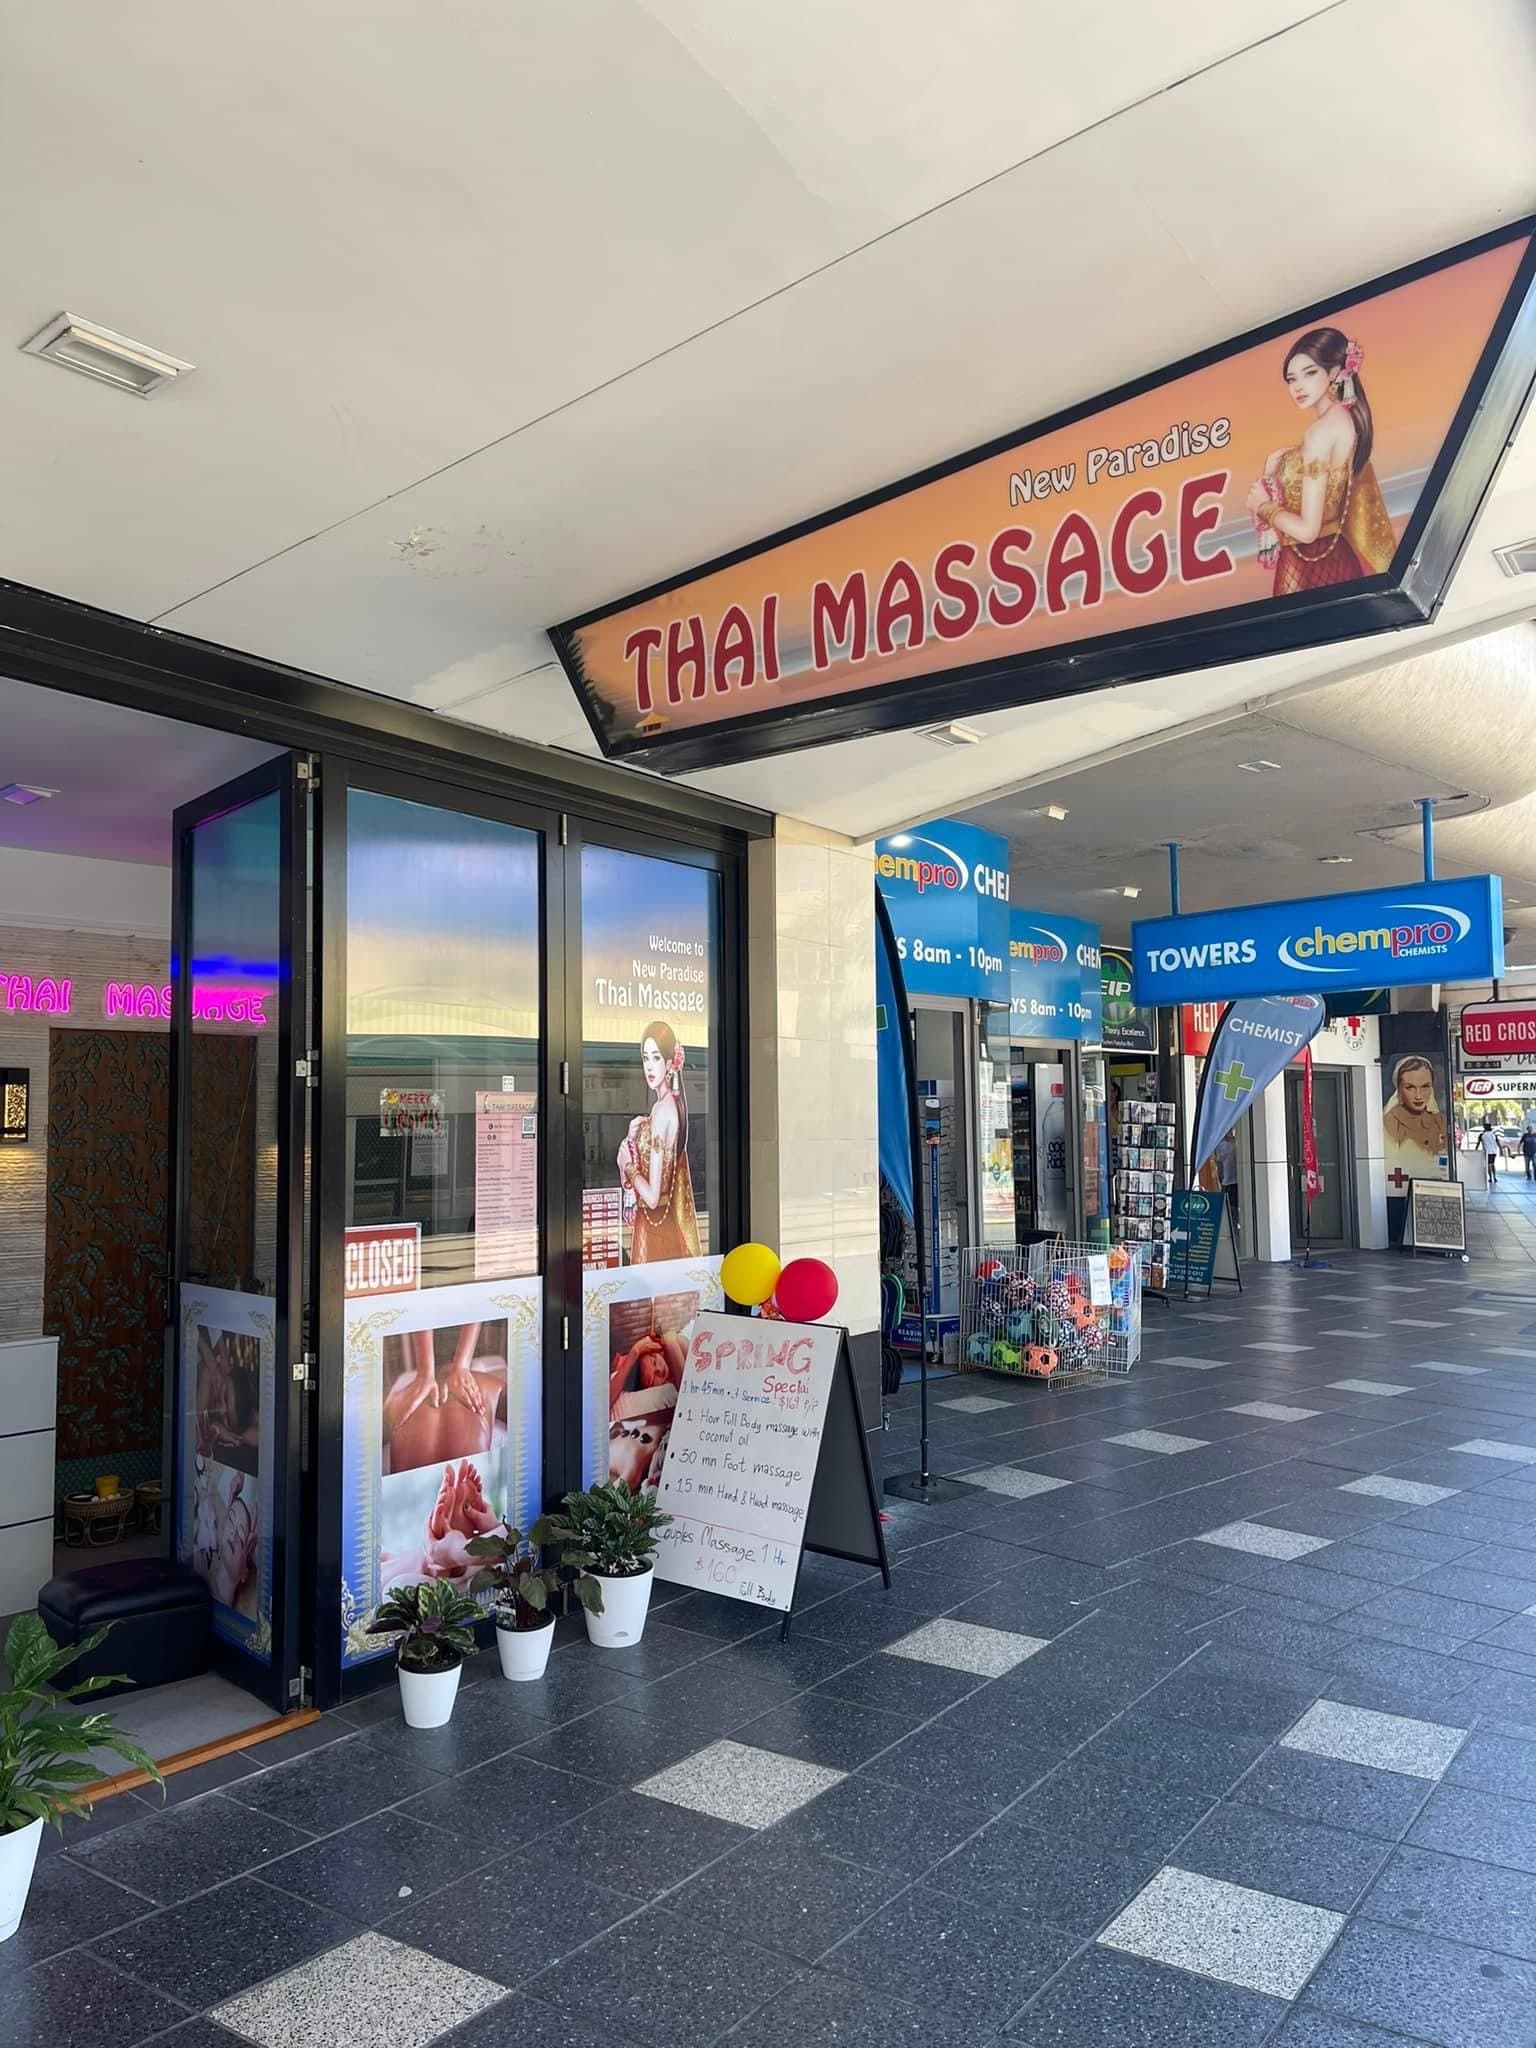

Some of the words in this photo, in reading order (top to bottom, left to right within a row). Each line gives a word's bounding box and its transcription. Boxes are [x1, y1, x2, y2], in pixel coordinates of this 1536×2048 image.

[1009, 462, 1077, 507] New
[1086, 416, 1232, 485] Paradise
[624, 594, 780, 711] THAI
[811, 471, 1235, 665] MASSAGE
[875, 853, 958, 894] empro
[973, 863, 1009, 902] CHE
[649, 935, 692, 956] Welcome
[694, 942, 704, 957] to
[912, 938, 951, 965] 8am
[968, 945, 1003, 976] 10pm
[1146, 938, 1257, 974] TOWERS
[1294, 920, 1454, 959] chempro
[1399, 943, 1448, 958] CHEMISTS
[632, 959, 656, 979] New
[660, 962, 705, 984] Paradise
[594, 977, 633, 1008] Thai
[638, 983, 705, 1013] Massage
[1030, 999, 1057, 1017] 8am
[1067, 1002, 1092, 1023] 10pm
[1229, 1017, 1304, 1048] CHEMIST
[1465, 1023, 1491, 1043] RED
[1468, 1080, 1493, 1093] IGA
[344, 1240, 415, 1291] CLOSED
[691, 1331, 815, 1375] SPRING
[686, 1409, 694, 1421] 1
[700, 1408, 720, 1425] Hour
[723, 1410, 738, 1427] Full
[739, 1413, 762, 1434] Body
[698, 1428, 733, 1443] coconut
[678, 1447, 698, 1465] 30
[723, 1452, 747, 1473] Foot
[752, 1463, 802, 1487] massage
[675, 1478, 693, 1493] 15
[697, 1482, 714, 1495] min
[771, 1500, 805, 1523] massage
[654, 1521, 695, 1548] Couples
[700, 1525, 755, 1562] Massage
[774, 1547, 787, 1566] Hr
